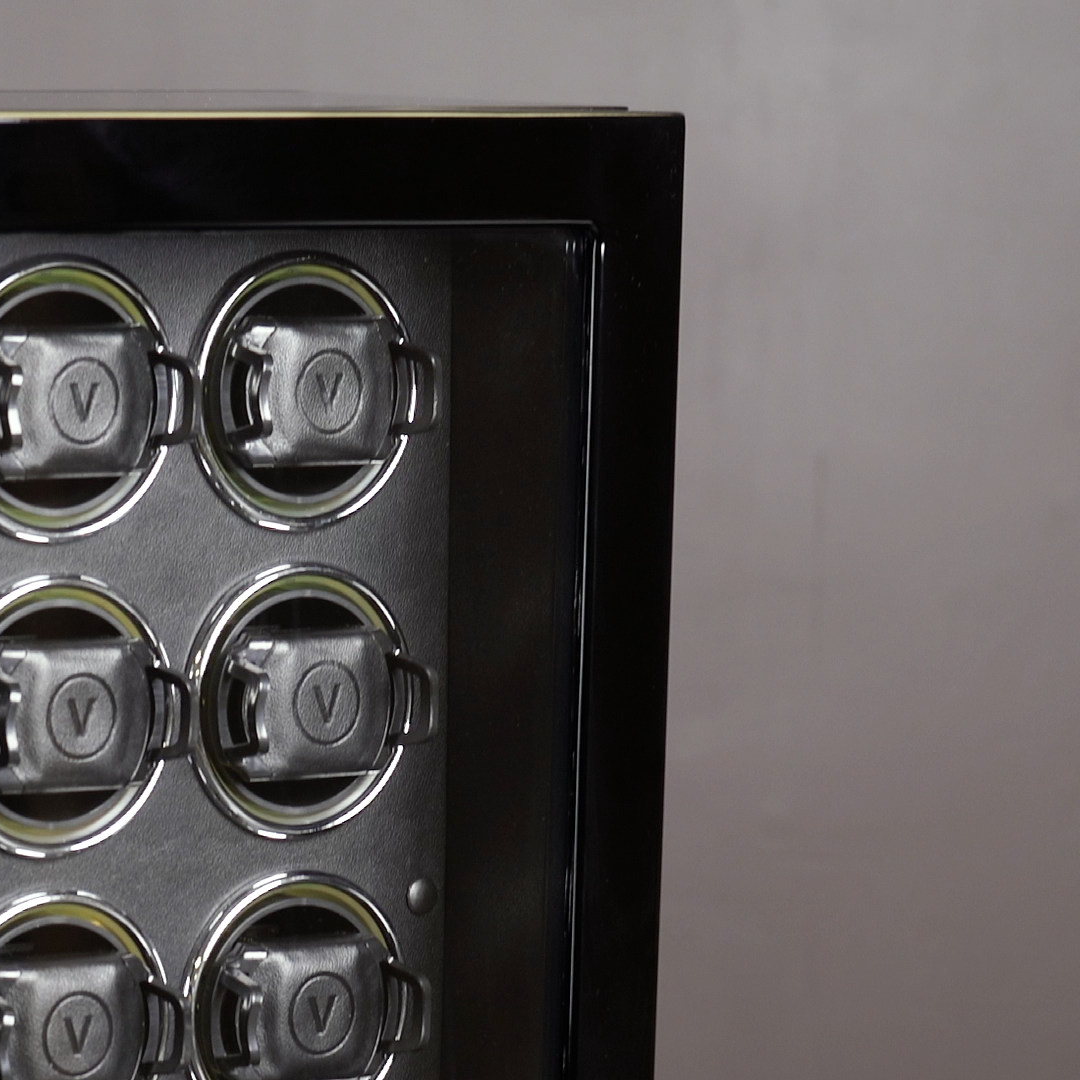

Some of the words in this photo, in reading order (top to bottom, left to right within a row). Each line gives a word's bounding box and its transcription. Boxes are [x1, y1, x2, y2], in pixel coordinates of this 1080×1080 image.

[69, 383, 100, 422] V
[316, 373, 344, 413] V
[67, 698, 97, 738] V
[312, 683, 341, 723] V
[308, 994, 337, 1034] V
[63, 1015, 92, 1055] V
